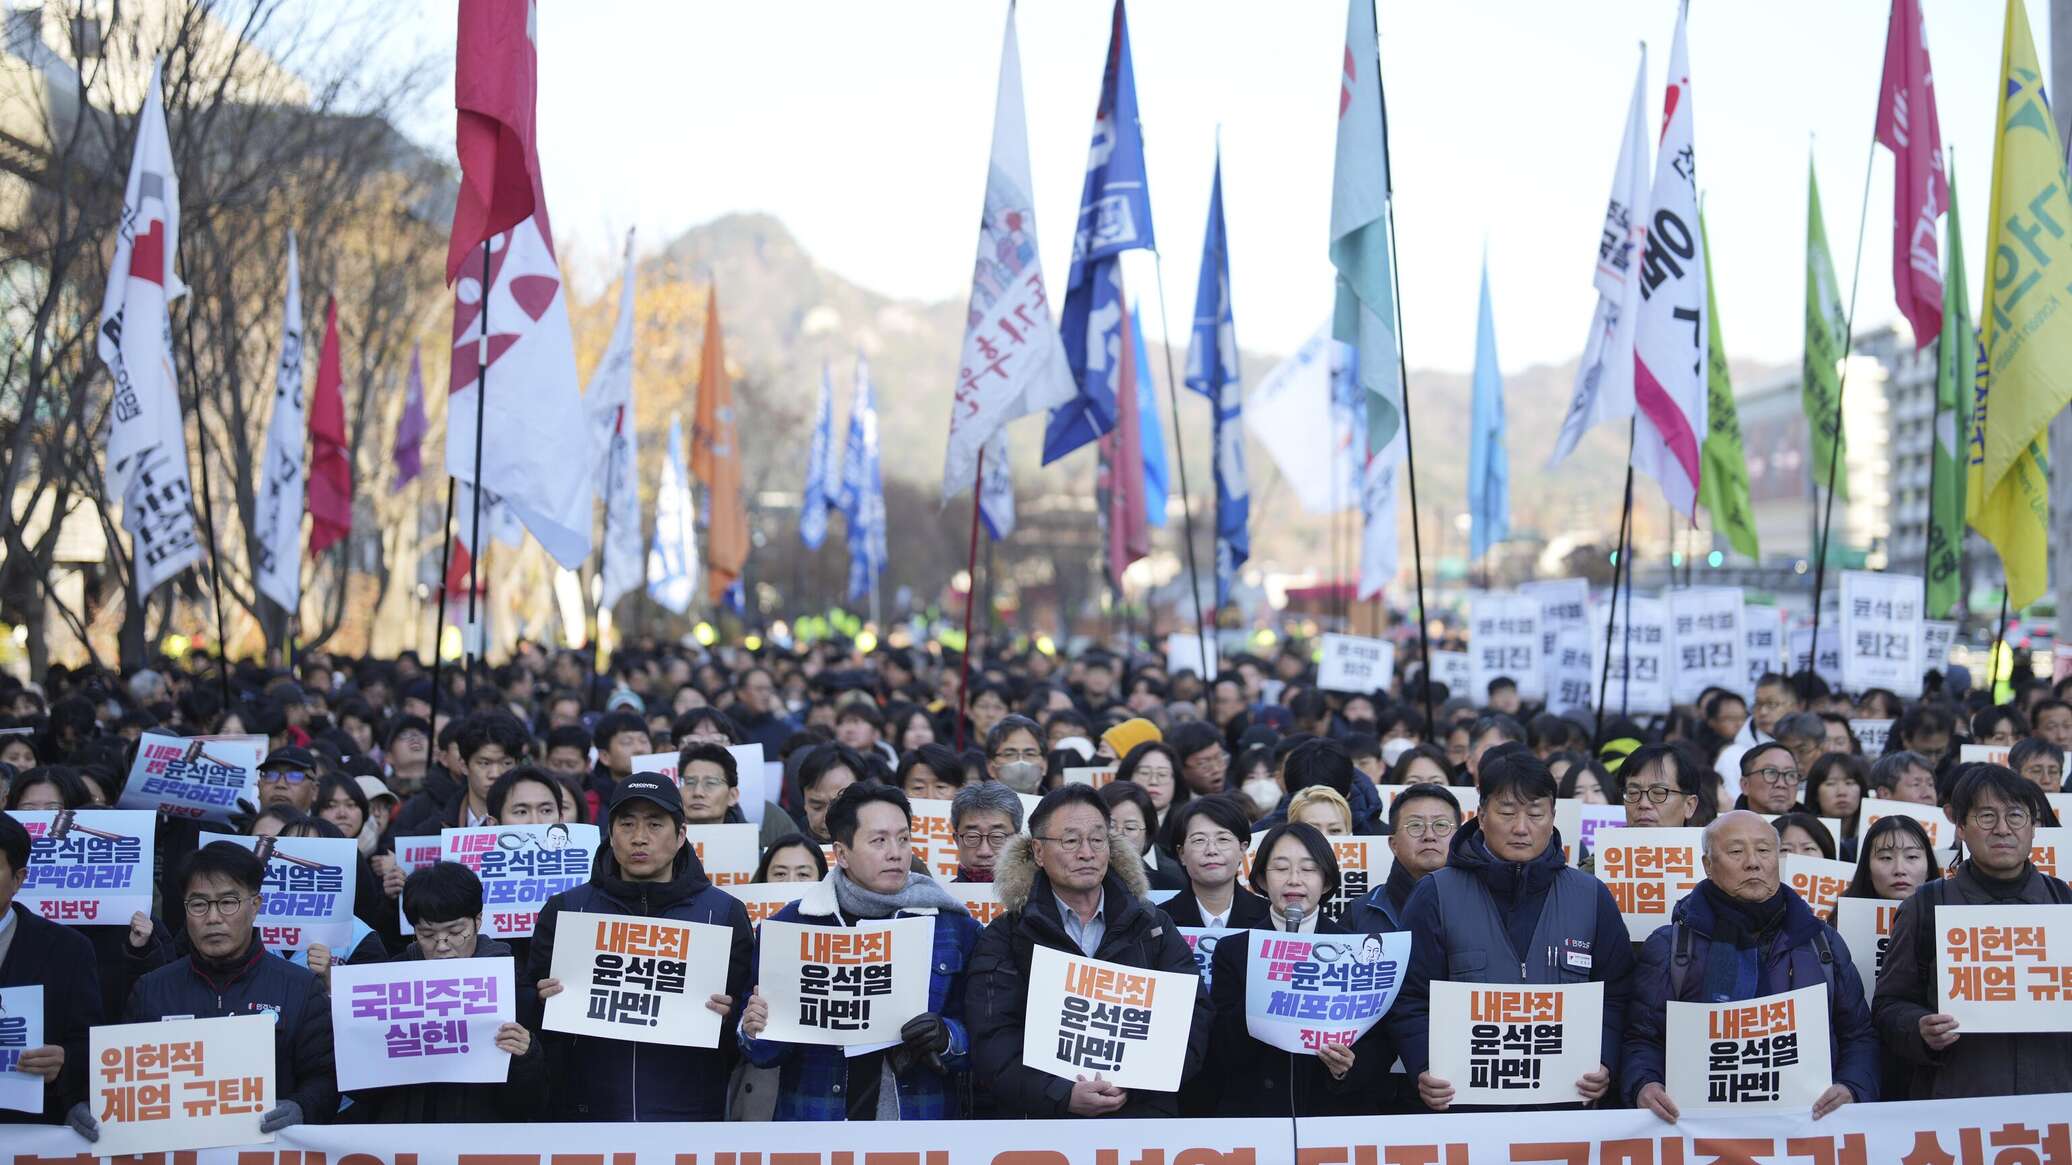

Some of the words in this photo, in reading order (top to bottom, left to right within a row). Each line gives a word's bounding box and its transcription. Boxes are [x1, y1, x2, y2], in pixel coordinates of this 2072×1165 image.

[1483, 646, 1531, 670] 퇴진
[1683, 641, 1733, 671] 퇴진
[1857, 630, 1909, 660] 퇴진
[144, 744, 182, 762] 내란
[164, 759, 247, 788] 윤석열을
[141, 777, 239, 806] 탄핵하라!
[31, 836, 141, 864] 윤석열을
[451, 833, 497, 853] 내란
[260, 864, 343, 893] 석열을
[481, 848, 589, 878] 윤석열을
[1604, 846, 1693, 879] 위헌적
[39, 900, 100, 920] 진보당
[494, 912, 539, 933] 진보
[262, 926, 301, 945] 보당
[595, 921, 690, 960] 내란죄
[800, 930, 892, 964] 내란죄
[1260, 939, 1312, 961] 내란
[1947, 926, 2046, 962] 위헌적
[592, 954, 687, 995] 윤석열
[799, 963, 892, 996] 윤석열
[1064, 962, 1156, 1008] 내란죄
[1292, 960, 1397, 992] 윤석열을
[1948, 966, 2016, 1001] 계엄
[352, 976, 499, 1021] 국민주권
[587, 988, 661, 1028] 파면!
[799, 997, 870, 1031] 파면!
[1266, 990, 1388, 1021] 체포하라!
[1470, 991, 1563, 1023] 내란죄
[1059, 996, 1151, 1041] 윤석열
[1708, 998, 1796, 1040] 내란죄
[385, 1020, 470, 1058] 실현!
[1056, 1030, 1125, 1072] 파면!
[1470, 1024, 1563, 1055] 윤석열
[1708, 1032, 1799, 1072] 윤석열
[100, 1040, 204, 1083] 위헌적
[1469, 1059, 1541, 1090] 파면!
[101, 1083, 171, 1123] 계엄
[183, 1077, 264, 1118] 규탄!
[1708, 1070, 1780, 1103] 파면!
